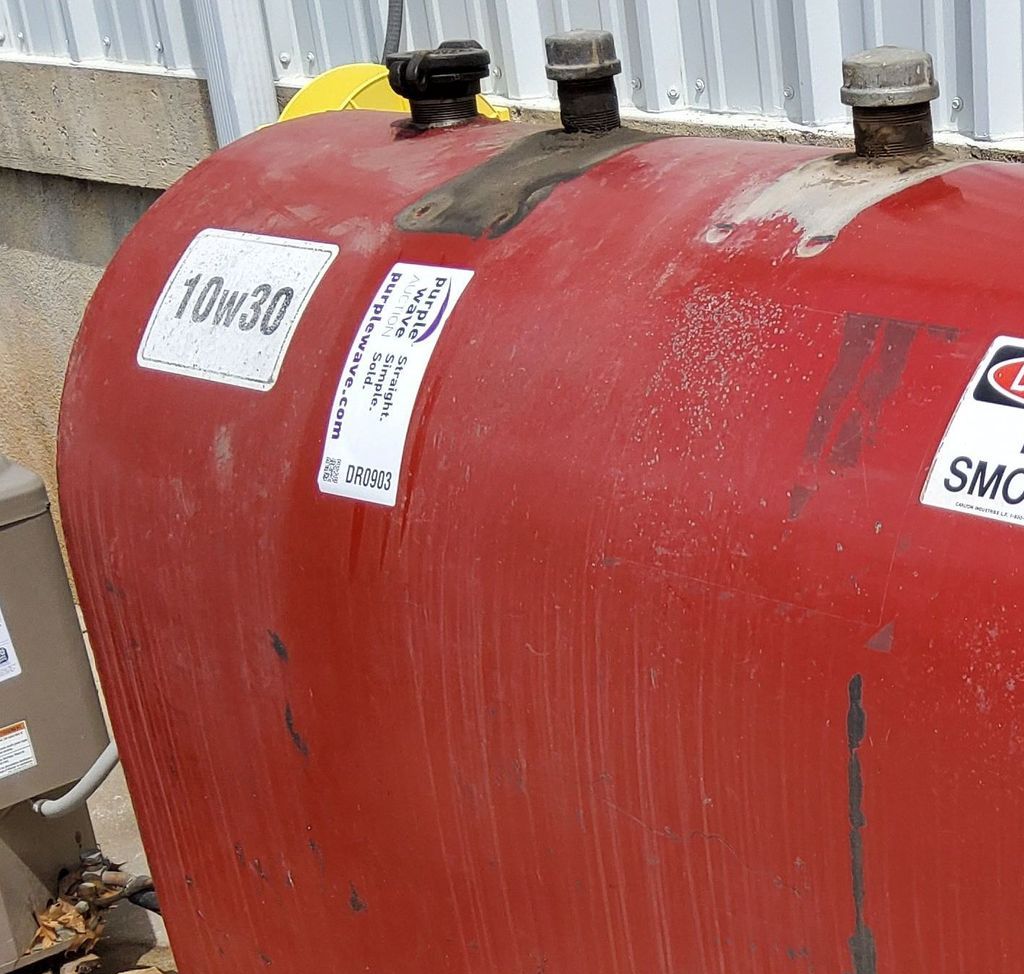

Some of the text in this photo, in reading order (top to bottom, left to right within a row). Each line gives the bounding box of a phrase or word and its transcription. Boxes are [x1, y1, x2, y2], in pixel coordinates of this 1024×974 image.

[174, 274, 294, 336] 10w30
[395, 287, 428, 338] wave
[408, 277, 447, 340] purple
[331, 272, 402, 440] purplewave.com
[362, 351, 383, 390] Sold.
[368, 353, 395, 412] Simple.
[379, 355, 408, 422] Straight.
[345, 464, 392, 491] DR0903
